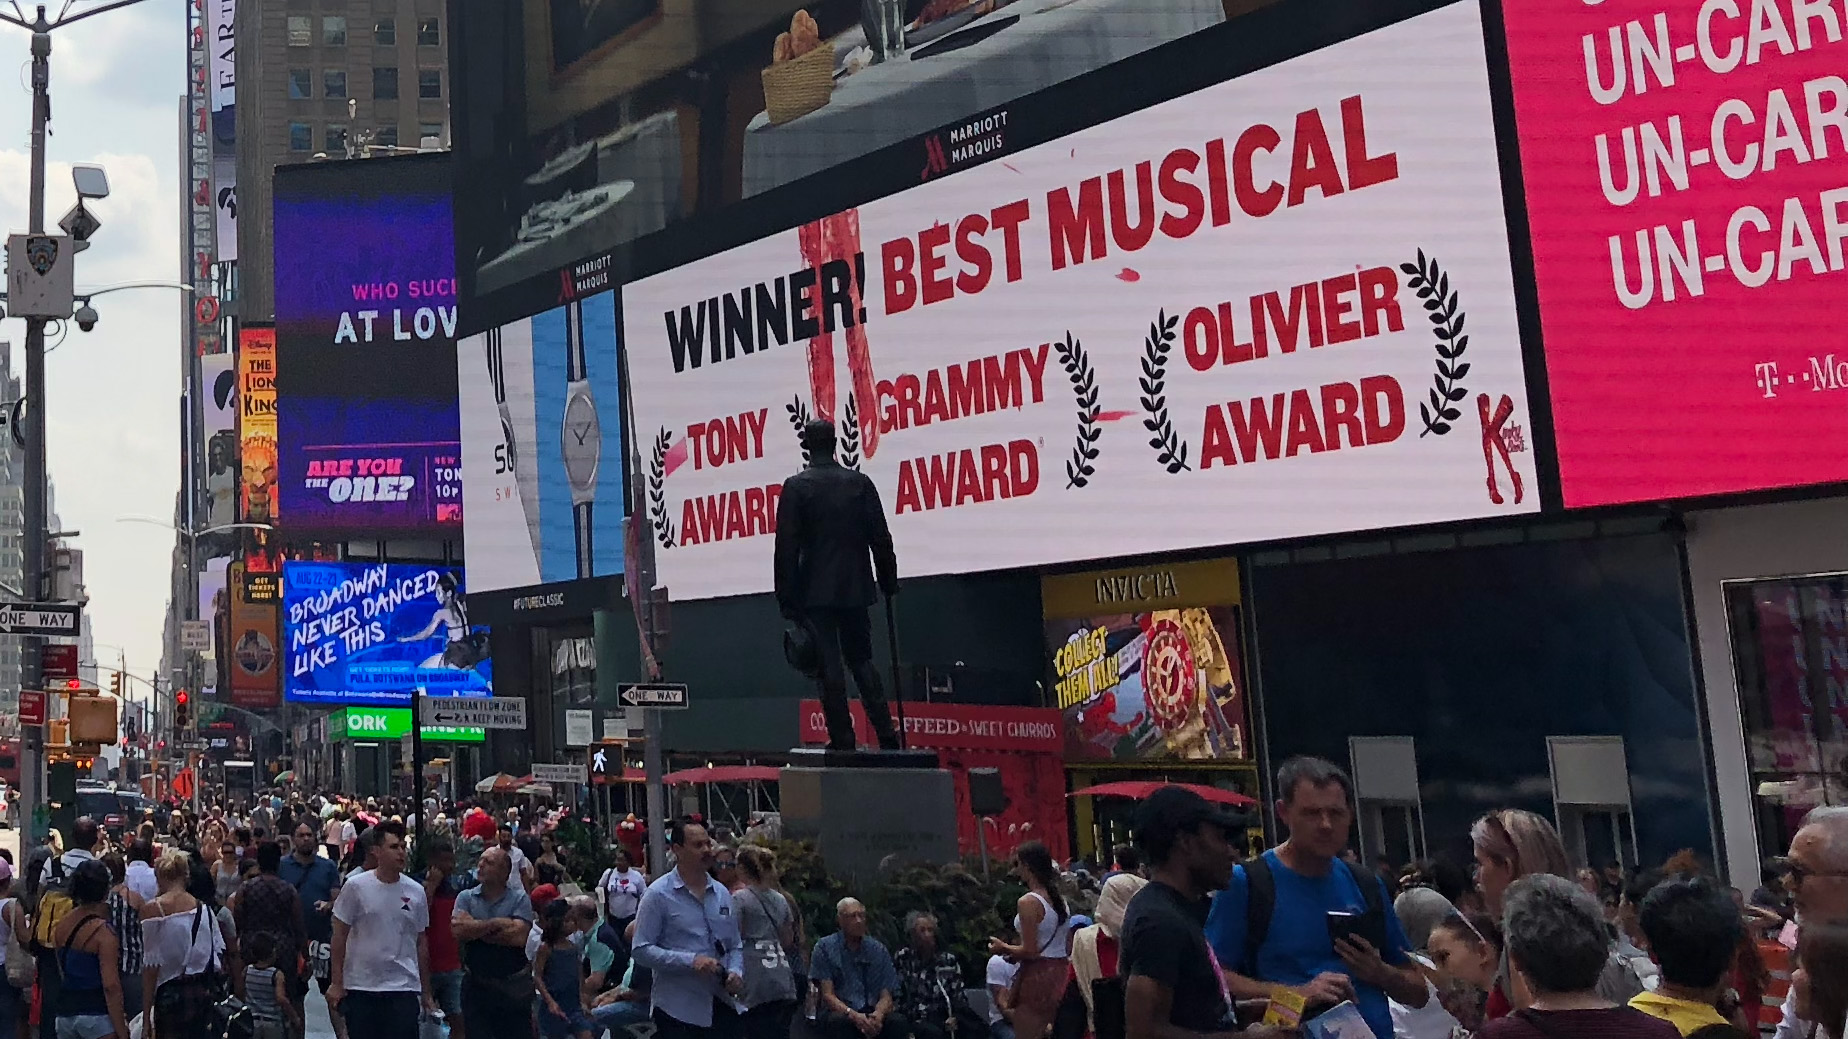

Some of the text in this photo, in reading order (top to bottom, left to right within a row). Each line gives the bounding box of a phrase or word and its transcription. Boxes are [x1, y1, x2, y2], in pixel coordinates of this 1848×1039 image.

[950, 111, 1008, 145] MARRIOTT
[952, 134, 1003, 164] MARQUIS
[665, 93, 1398, 374] WINNER! BEST MUSICAL
[575, 254, 612, 278] MARRIOTT
[352, 279, 457, 301] WHO SUC
[576, 272, 608, 293] MARQUIS
[334, 305, 459, 344] AT LOV
[249, 360, 272, 371] THE
[687, 264, 1406, 470] TONY GRAMMY OLIVIER
[894, 440, 1040, 516] AWARD
[1199, 375, 1407, 470] AWARD
[307, 459, 403, 477] ARE YOU
[305, 478, 330, 488] THE
[296, 572, 312, 585] AUG
[1094, 571, 1180, 605] INVICTA
[289, 563, 388, 624] BROADWAY
[0, 612, 69, 627] ONE WAY
[292, 570, 440, 652] NEVER DANCED
[293, 621, 386, 677] LIKE THIS
[1054, 625, 1108, 677] COLLECT
[1055, 654, 1121, 710] THEM ALL!
[432, 700, 522, 712] PEDESTRIAN FLOW ZONE
[627, 690, 680, 702] ONE WAY
[472, 714, 522, 726] KEEP MOVING
[969, 719, 1057, 739] SWEET CHURROS
